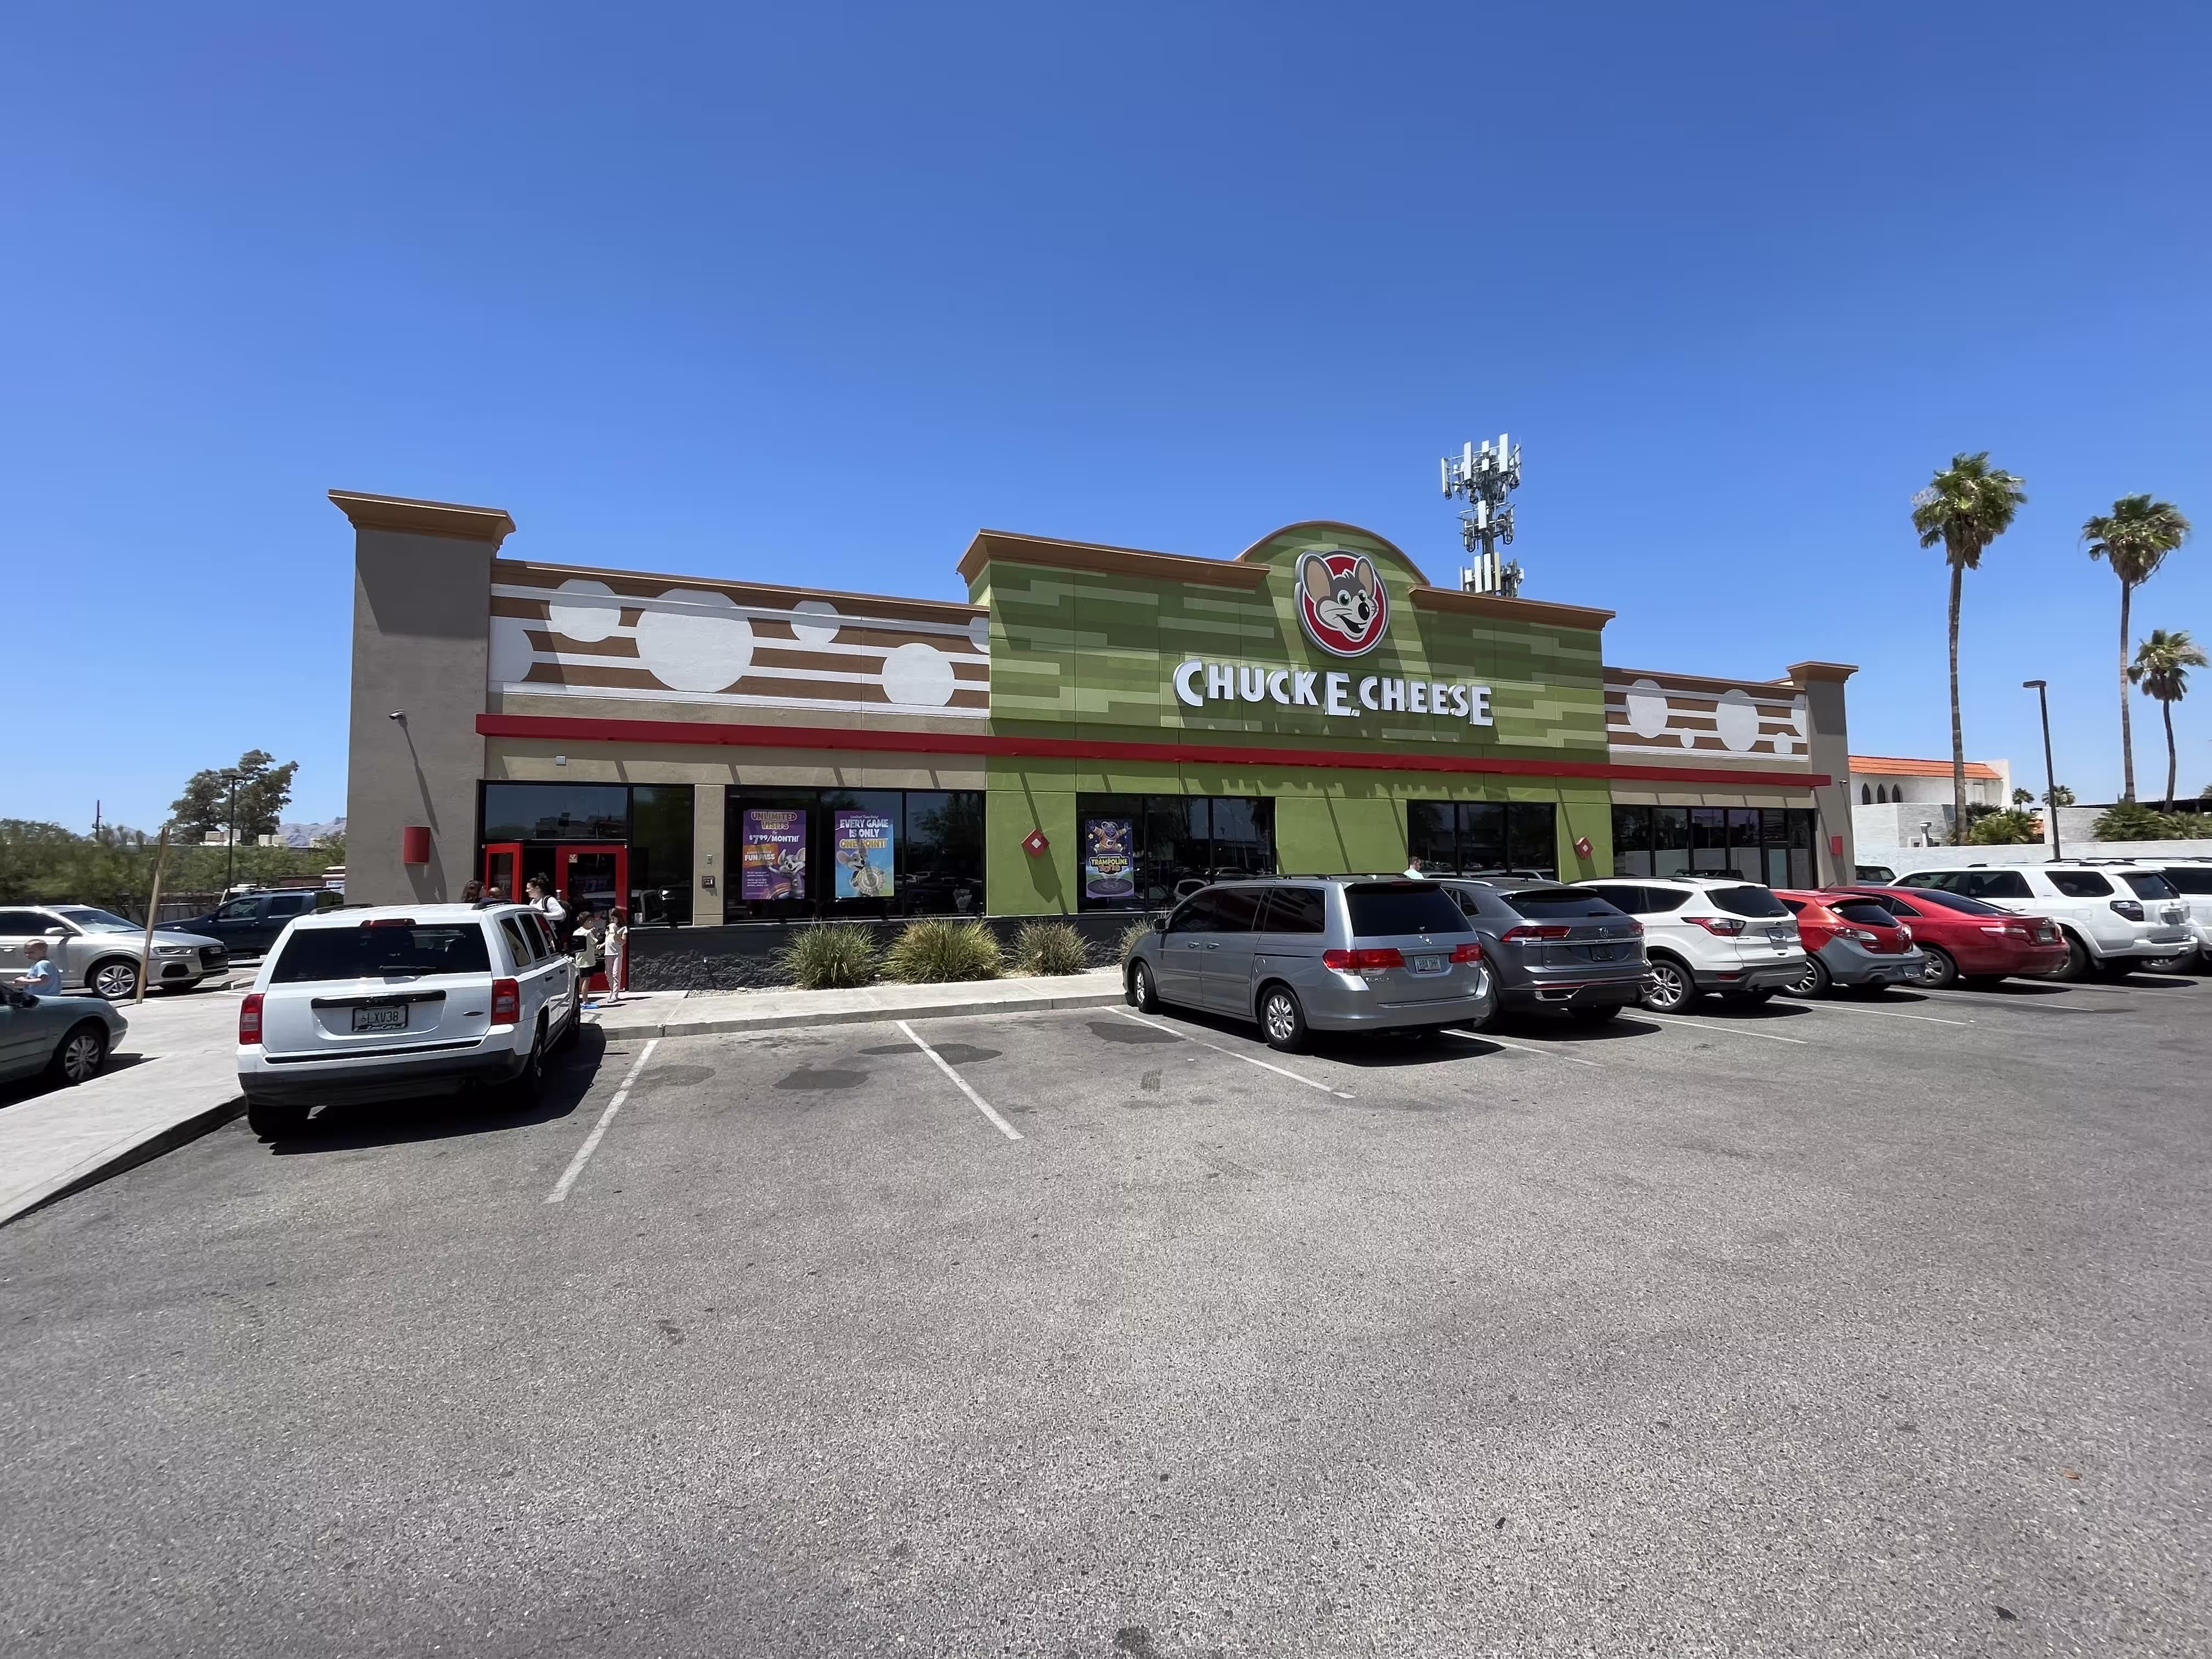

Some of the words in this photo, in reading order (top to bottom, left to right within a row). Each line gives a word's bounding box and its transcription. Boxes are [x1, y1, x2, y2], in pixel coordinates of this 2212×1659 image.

[1173, 658, 1318, 707] CHUCK
[1325, 672, 1361, 716] E.
[1359, 676, 1494, 726] CHEESE
[751, 812, 797, 821] UNLIMITED
[761, 821, 789, 830] VISITS
[840, 819, 865, 828] EVERY
[867, 819, 889, 828] GAME
[849, 829, 857, 838] IS
[859, 829, 879, 838] ONLY
[839, 839, 858, 849] ONE
